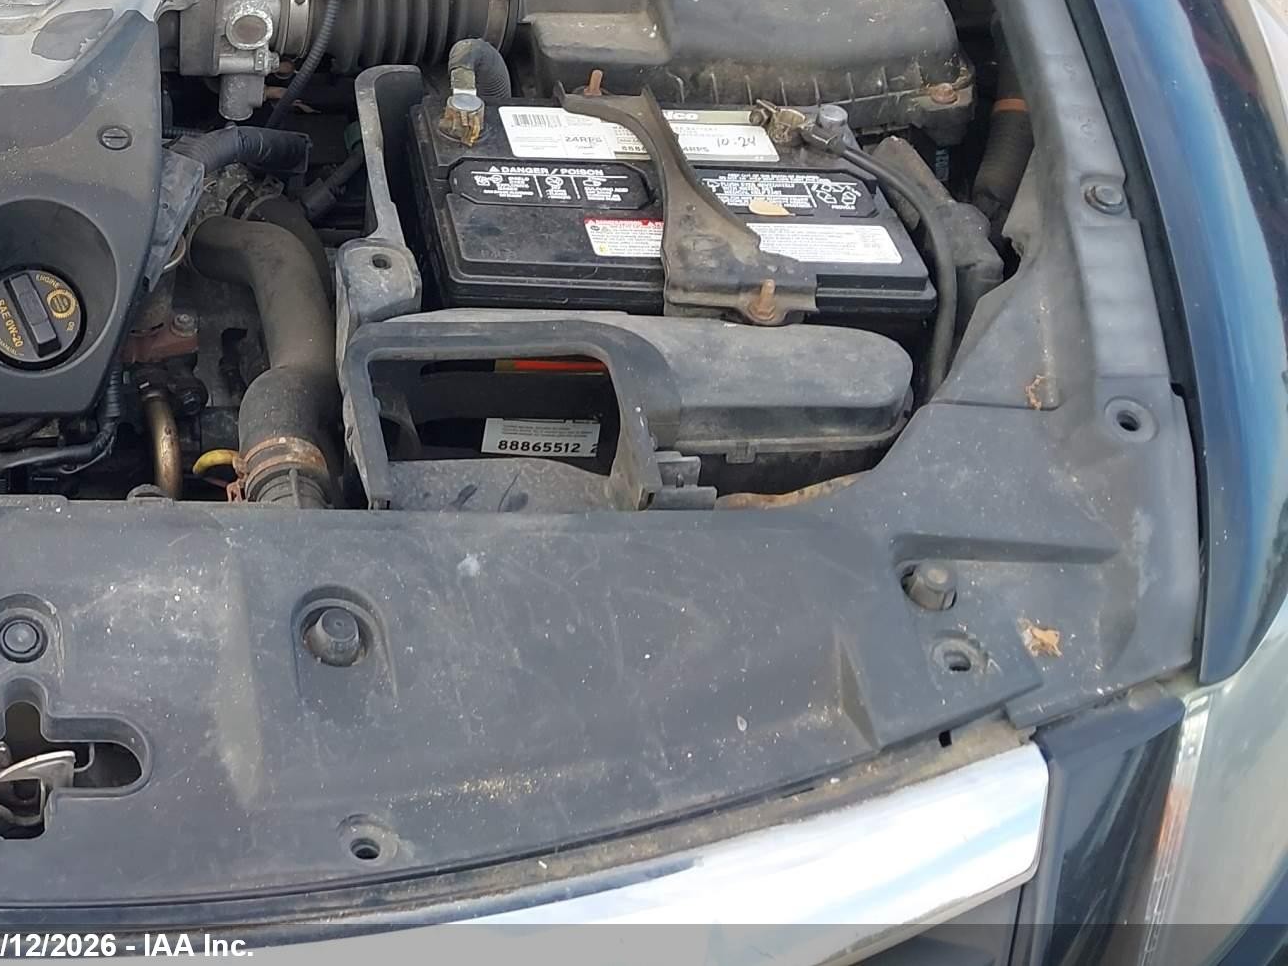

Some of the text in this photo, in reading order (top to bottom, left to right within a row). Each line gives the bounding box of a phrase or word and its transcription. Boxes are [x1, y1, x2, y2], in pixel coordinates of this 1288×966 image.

[501, 166, 548, 175] DANGER
[560, 168, 604, 176] POISON
[5, 319, 24, 348] 0W-20
[498, 440, 581, 453] 88865512
